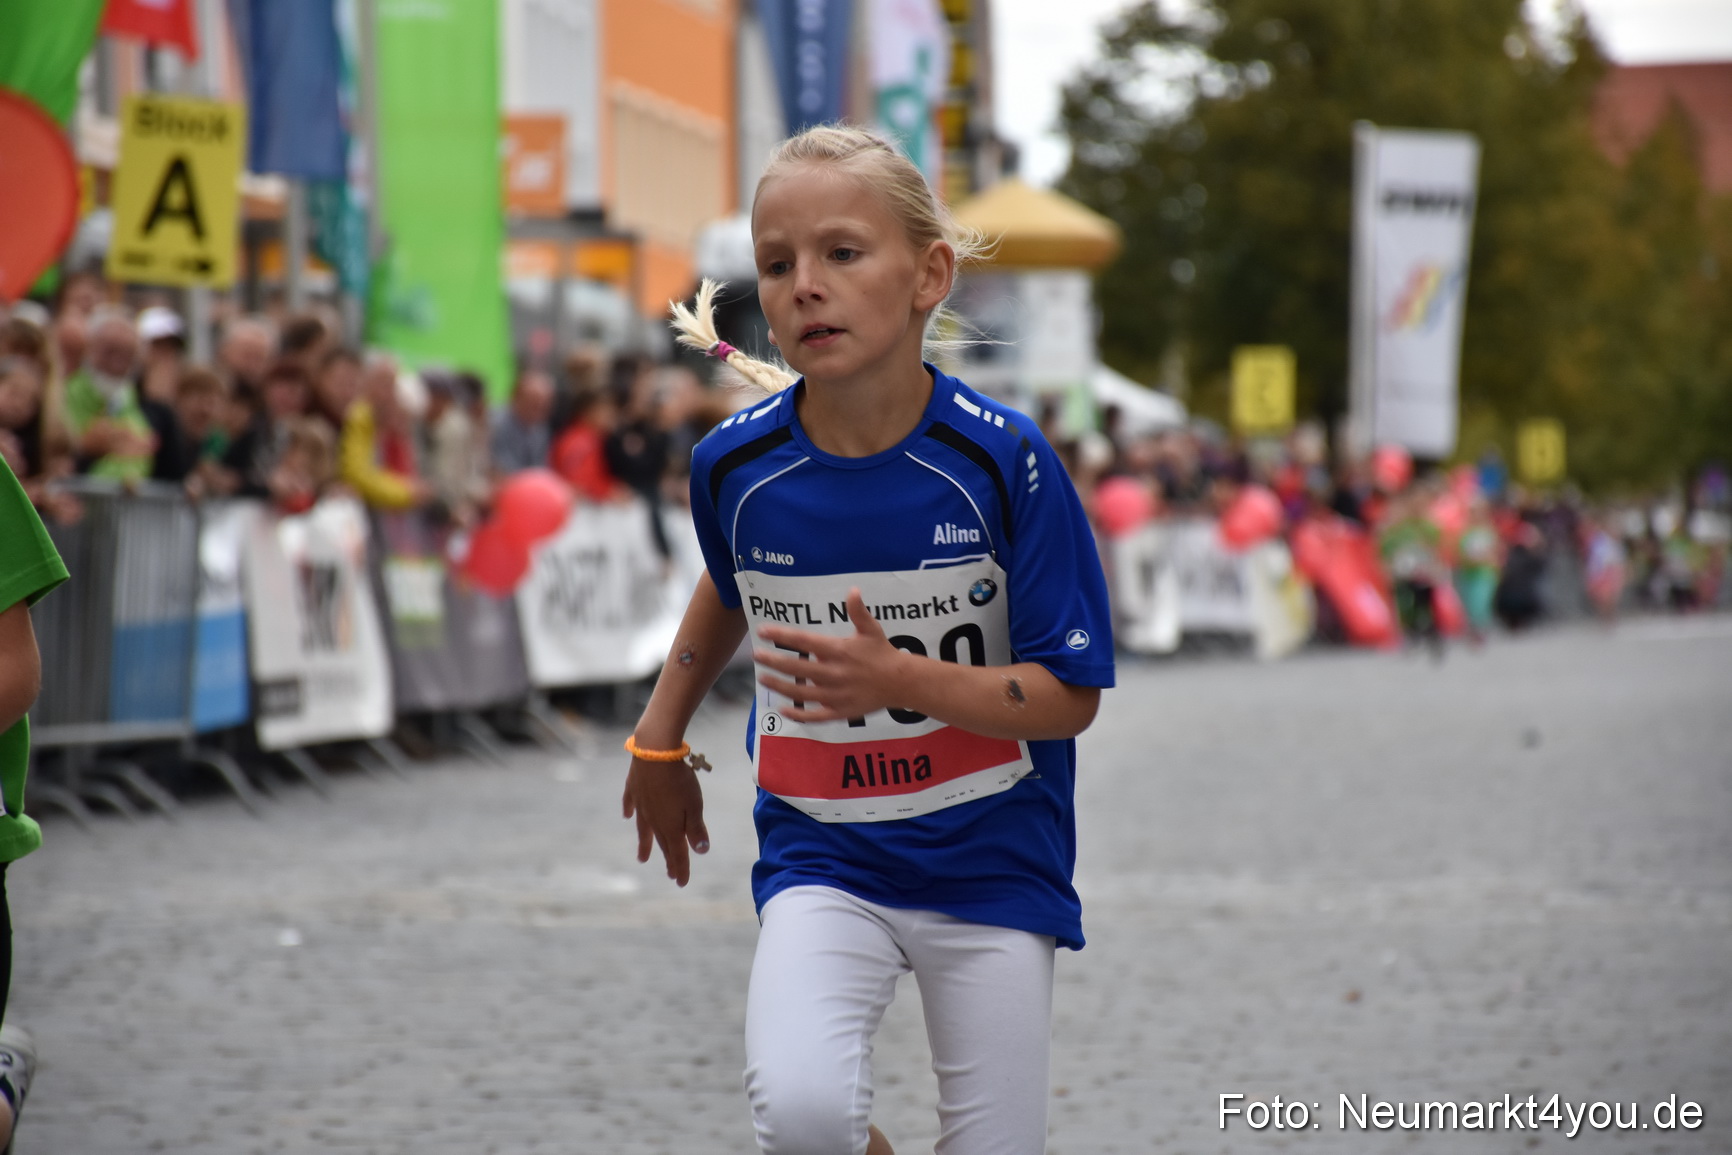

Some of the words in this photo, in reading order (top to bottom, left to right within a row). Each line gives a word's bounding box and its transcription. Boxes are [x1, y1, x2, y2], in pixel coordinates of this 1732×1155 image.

[140, 155, 207, 241] A
[933, 523, 980, 545] Alina
[764, 551, 795, 566] JAKO
[749, 595, 822, 625] PARTL
[828, 594, 960, 624] Numarkt
[766, 716, 776, 733] 3
[841, 752, 932, 789] Alina
